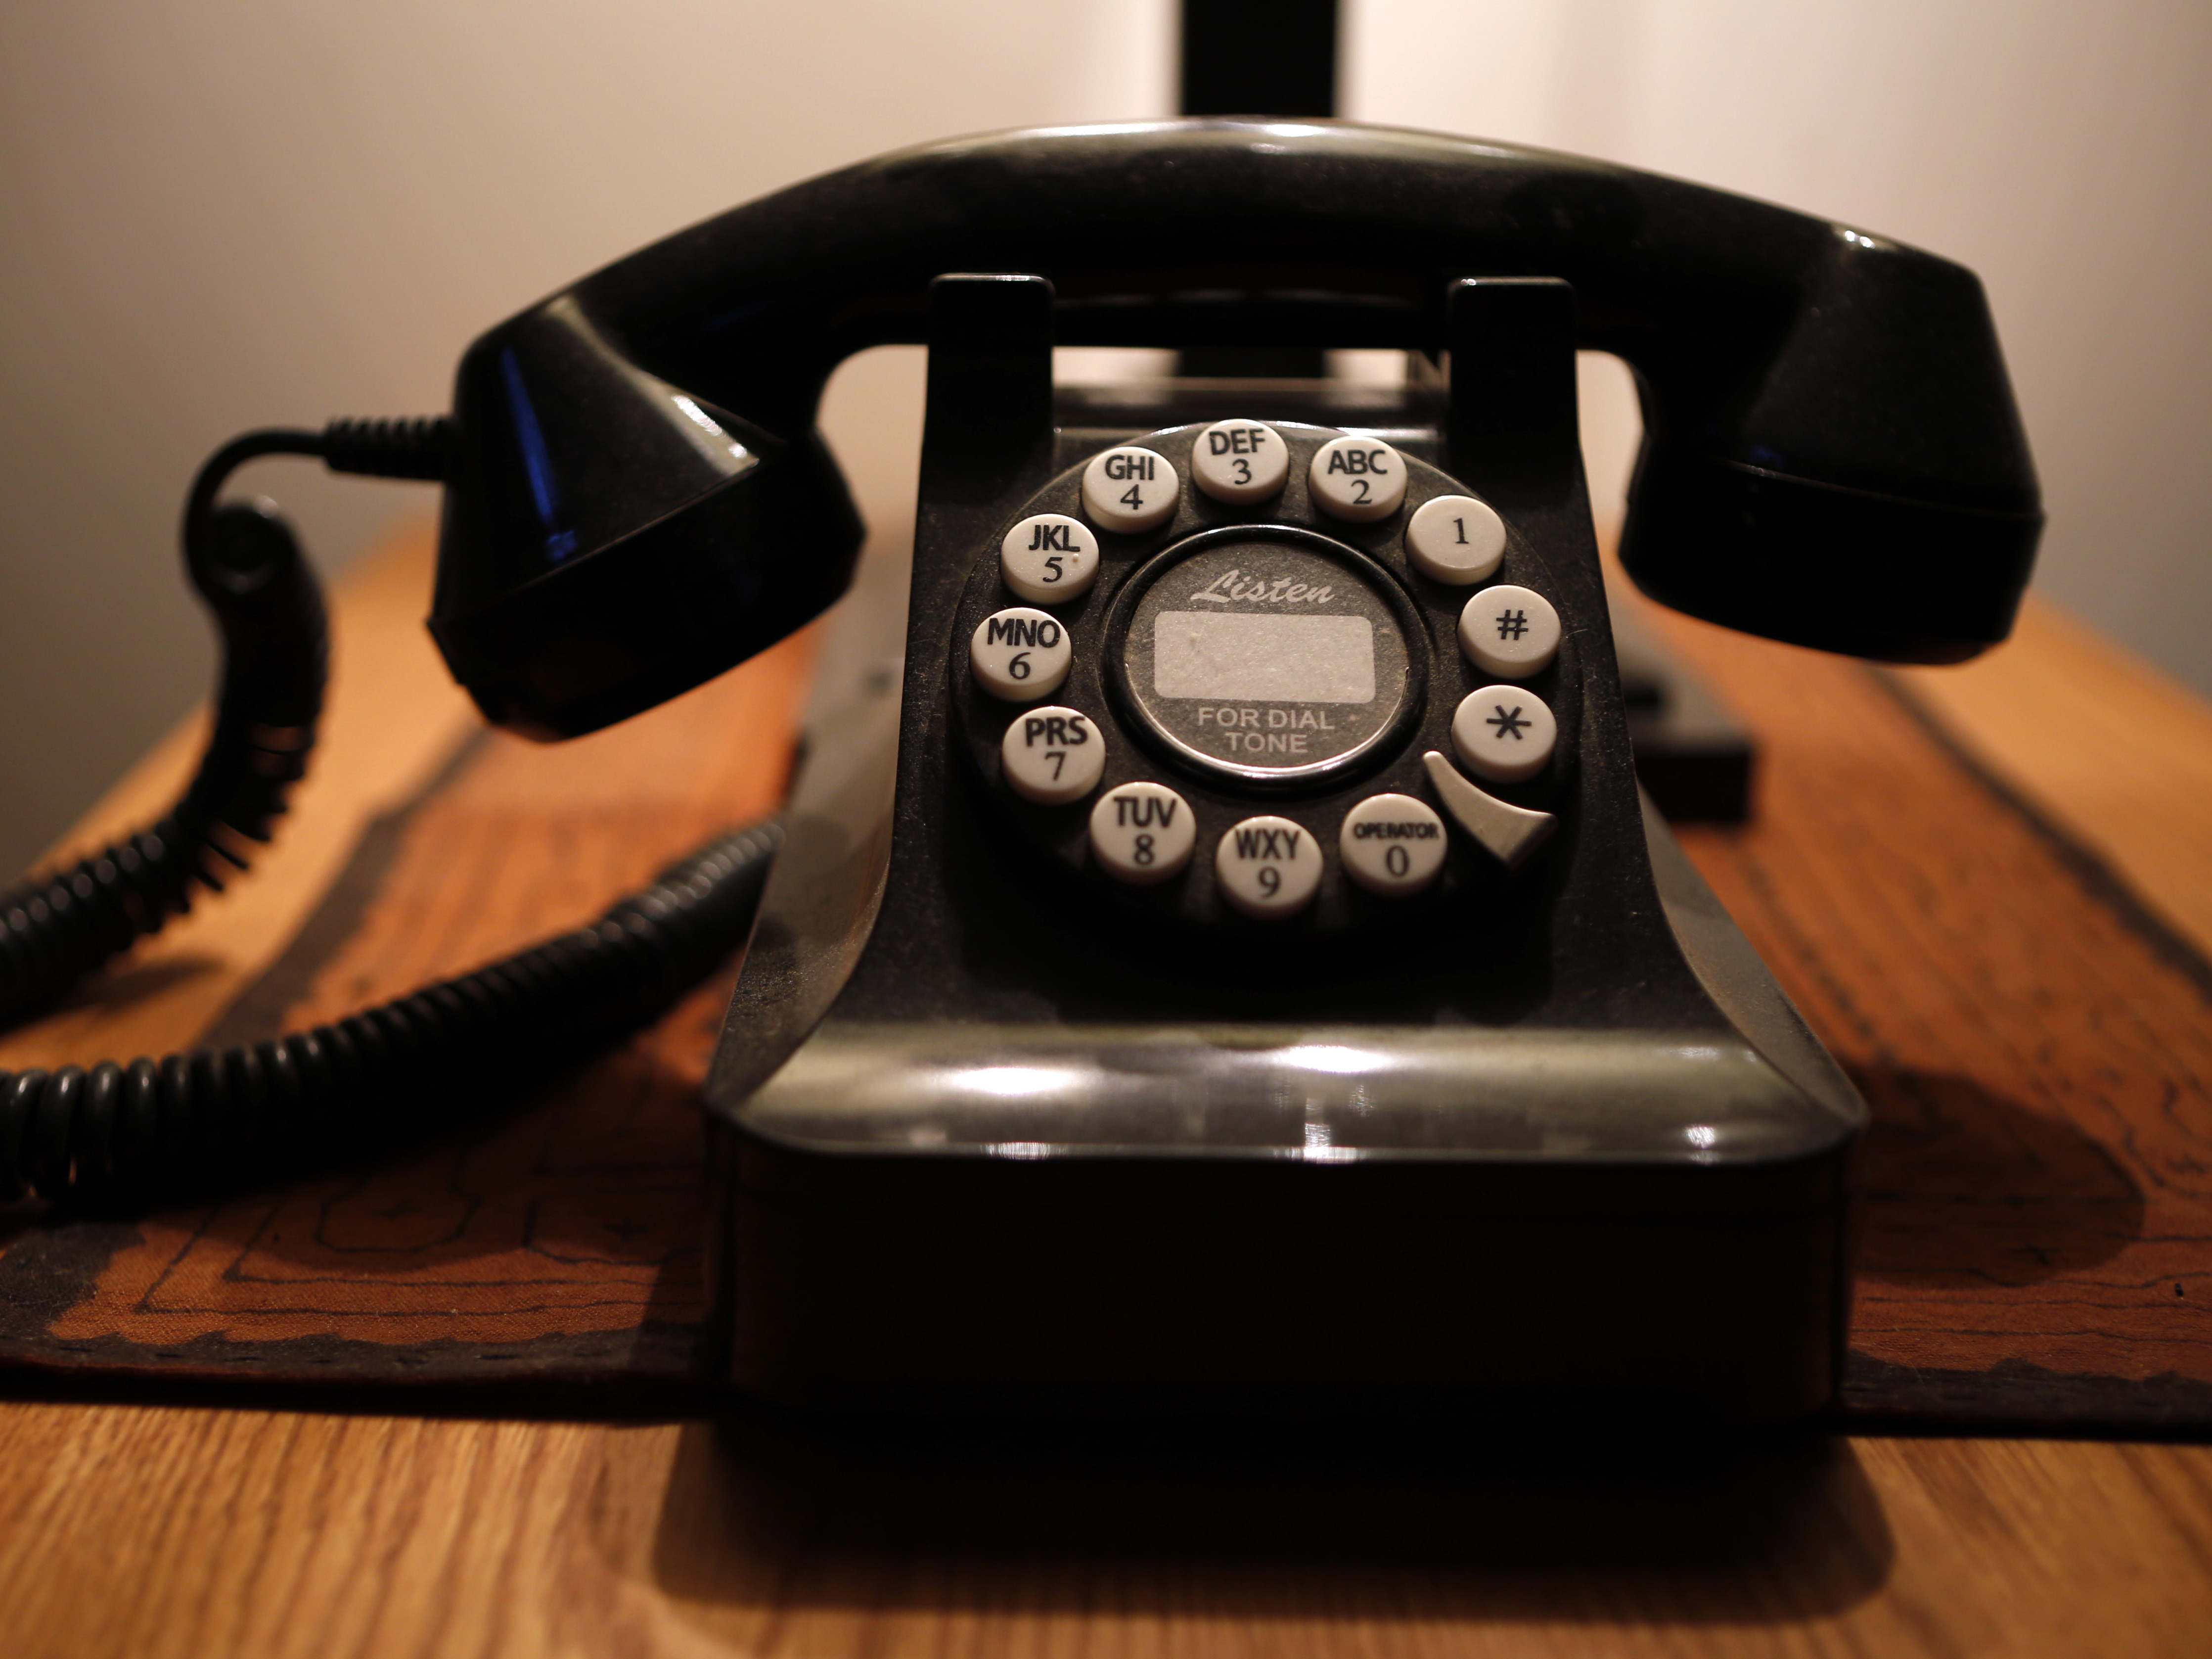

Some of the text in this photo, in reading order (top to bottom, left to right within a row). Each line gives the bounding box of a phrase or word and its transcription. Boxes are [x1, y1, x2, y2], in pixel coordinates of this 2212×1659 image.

[1209, 428, 1265, 455] DEF
[1105, 454, 1155, 480] GHI
[1232, 459, 1252, 484] 3
[1327, 449, 1388, 475] ABC
[1120, 484, 1143, 510] 4
[1351, 479, 1372, 505] 2
[1028, 524, 1081, 552] JKL
[1453, 517, 1469, 544] 1
[1042, 556, 1063, 583] 5
[1190, 569, 1335, 604] Listen
[987, 618, 1060, 648] MNO
[1496, 609, 1529, 641] #
[1008, 652, 1031, 680] 6
[1025, 716, 1089, 747] PRS
[1198, 707, 1335, 730] FOR DIAL
[1224, 732, 1309, 753] TONE
[1044, 751, 1067, 782] 7
[1113, 796, 1177, 828] TUV
[1354, 821, 1439, 839] OPERATOR
[1133, 834, 1155, 866] 8
[1236, 828, 1302, 861] WXY
[1385, 845, 1410, 877] 0
[1257, 866, 1281, 899] 9
